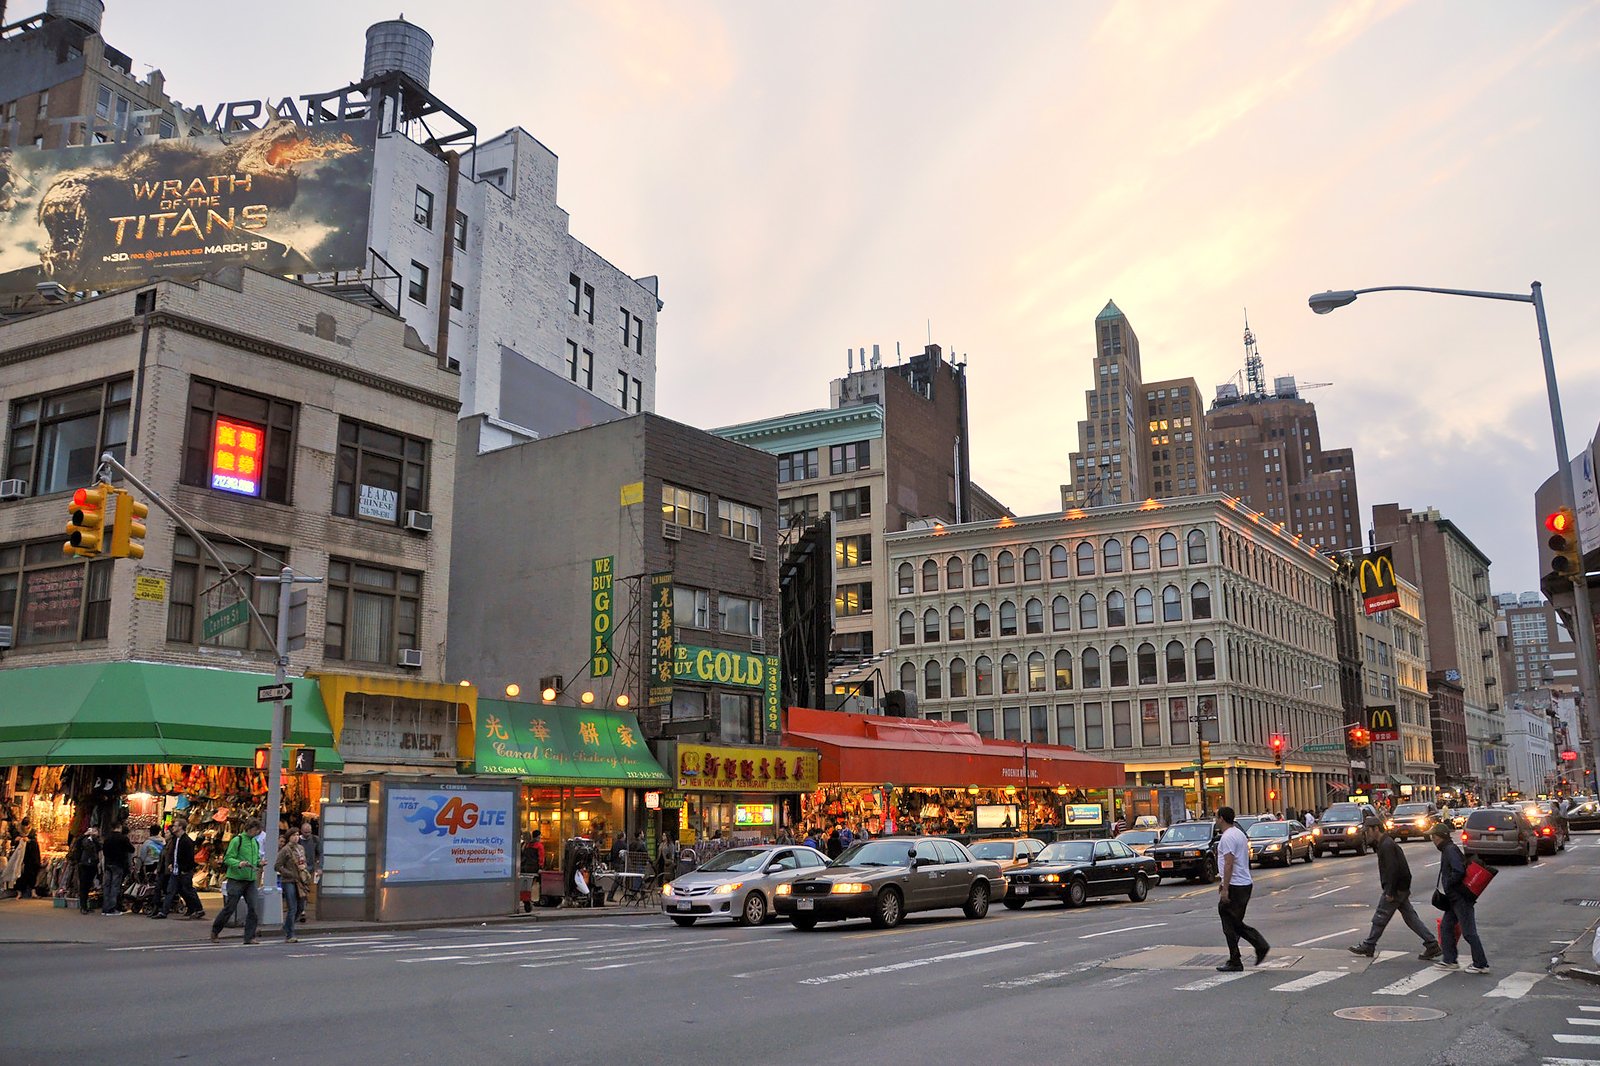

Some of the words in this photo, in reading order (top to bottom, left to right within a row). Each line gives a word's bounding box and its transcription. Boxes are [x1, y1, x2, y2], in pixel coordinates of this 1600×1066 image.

[133, 174, 252, 200] WRATH
[160, 199, 182, 210] OF
[188, 195, 220, 207] THE
[108, 204, 268, 247] TITANS
[170, 249, 190, 257] IMAX
[191, 248, 203, 256] 3D
[204, 243, 248, 255] MARCH
[360, 484, 395, 501] LEARN
[359, 498, 394, 511] CHINESE
[595, 558, 610, 573] WE
[592, 574, 612, 591] BUY
[210, 614, 231, 633] Centre
[231, 609, 239, 622] St
[594, 592, 610, 677] GOLD
[657, 587, 673, 682] 光華餅家
[697, 649, 763, 685] GOLD
[767, 657, 779, 666] 212
[277, 688, 287, 696] WAY
[492, 742, 538, 760] Canal
[483, 765, 498, 773] 242
[498, 765, 518, 774] Canal
[1002, 767, 1021, 778] PHOENIX
[690, 780, 702, 788] NEW
[736, 780, 768, 789] RESTAURANT
[399, 802, 420, 810] AT&T
[436, 797, 479, 835] 4G
[480, 810, 507, 826] LTE
[467, 848, 488, 856] speeds
